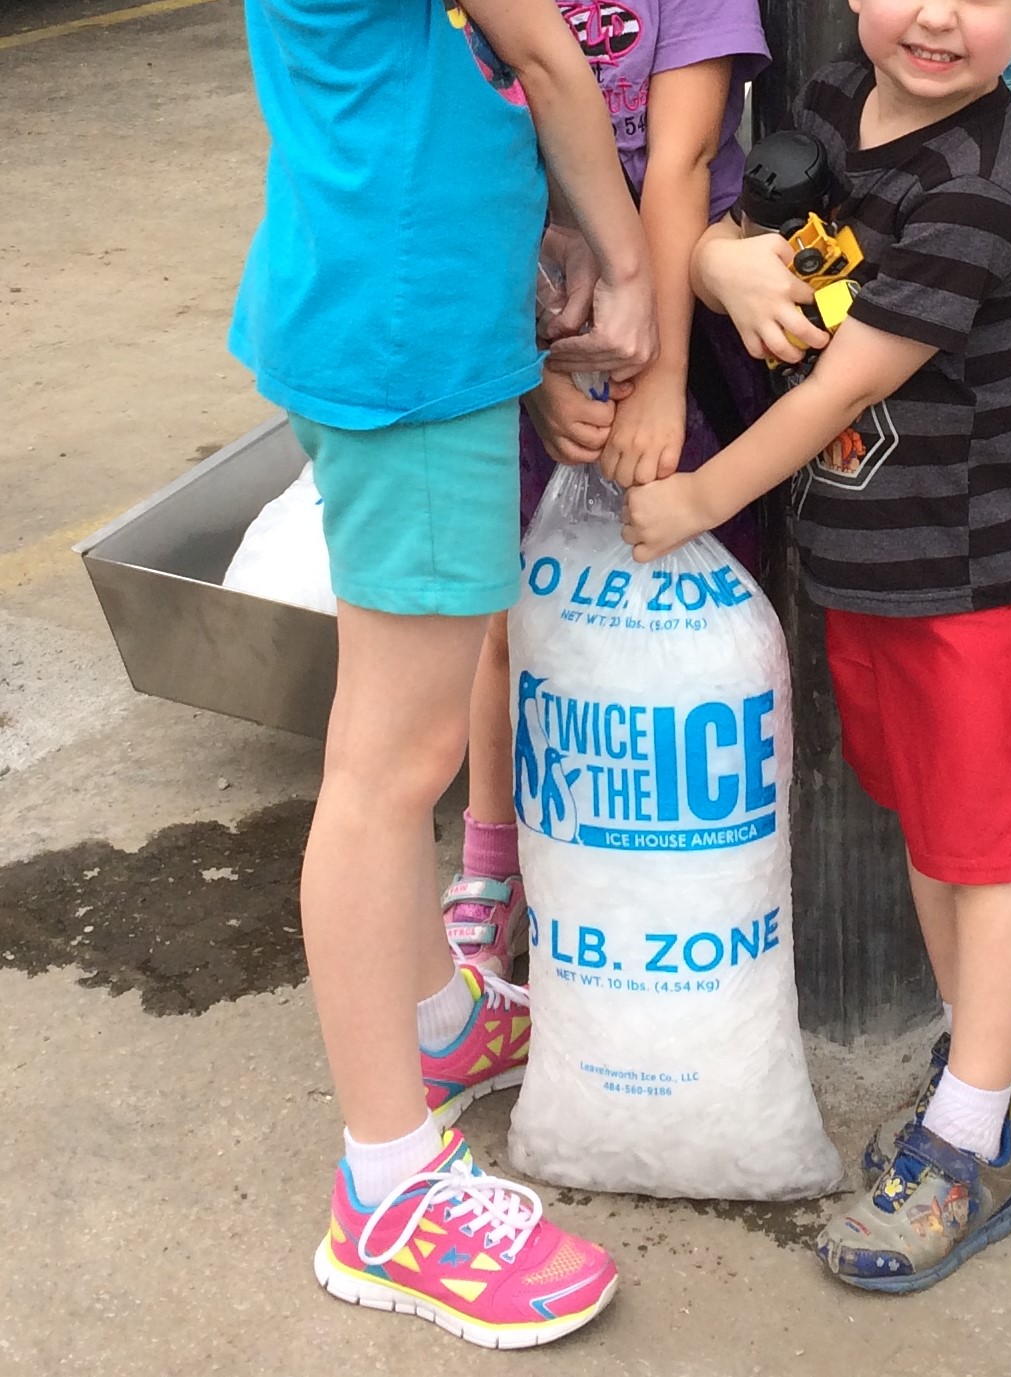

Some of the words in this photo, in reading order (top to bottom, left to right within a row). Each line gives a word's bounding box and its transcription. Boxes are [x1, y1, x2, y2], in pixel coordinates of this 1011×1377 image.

[570, 565, 632, 609] LB.
[647, 565, 753, 611] ZONE
[560, 609, 583, 622] NET
[626, 617, 645, 629] lbs.
[686, 618, 708, 631] Kg)
[541, 691, 648, 760] TWICE
[653, 689, 776, 822] ICE
[586, 765, 651, 821] THE
[605, 832, 630, 847] ICE
[635, 833, 687, 848] HOUSE
[691, 824, 758, 847] AMERICA
[552, 919, 622, 971] LB.
[646, 907, 780, 973] ZONE
[556, 968, 576, 982] NET
[581, 976, 604, 987] WT.
[608, 978, 622, 989] 10
[626, 980, 649, 991] lbs.
[655, 982, 691, 993] (4.54
[696, 978, 720, 992] Kg)
[580, 1061, 638, 1081] Leavenworth
[641, 1072, 657, 1081] Ice
[660, 1073, 678, 1083] Co.,
[681, 1072, 699, 1081] LLC
